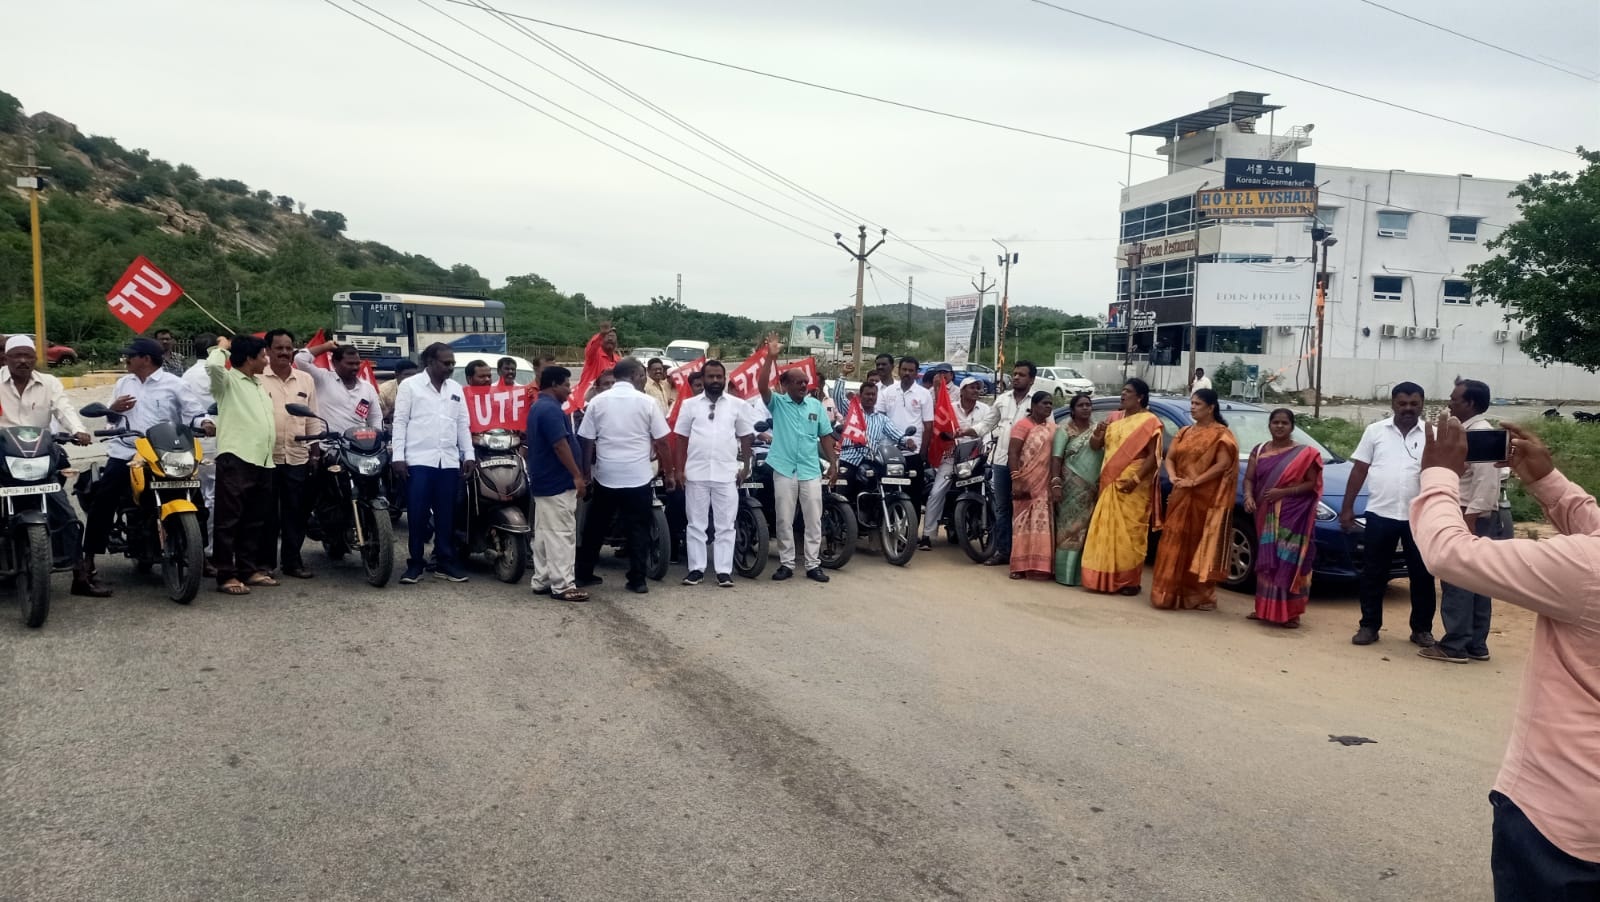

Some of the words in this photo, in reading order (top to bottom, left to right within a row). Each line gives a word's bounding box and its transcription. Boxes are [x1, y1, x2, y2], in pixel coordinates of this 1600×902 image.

[1267, 166, 1293, 176] 스토어
[1262, 178, 1305, 186] Supermarket
[1202, 192, 1253, 205] HOTEL
[1141, 244, 1163, 259] Korean
[1164, 239, 1196, 255] Restauran
[1216, 292, 1248, 301] EDEN
[1252, 292, 1301, 301] HOTELS
[371, 303, 398, 311] APSRTC
[474, 388, 525, 426] UTF
